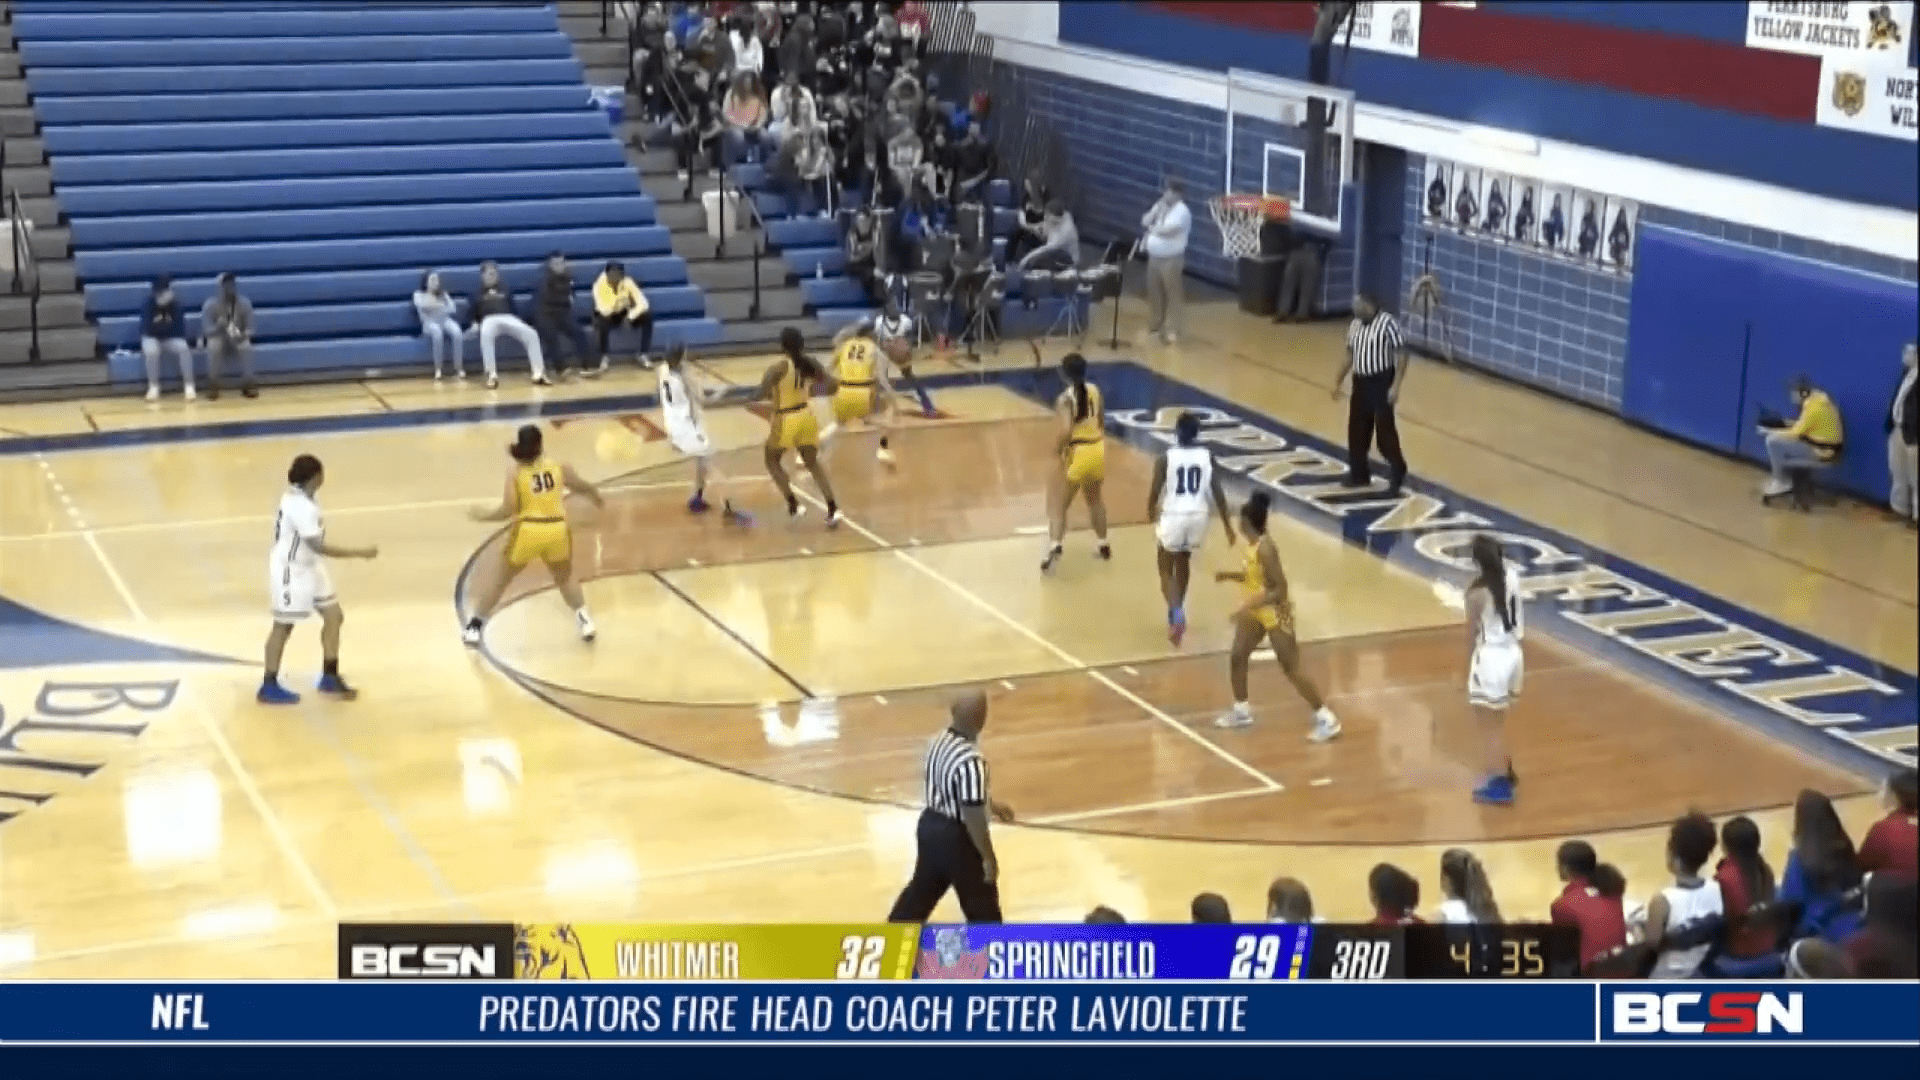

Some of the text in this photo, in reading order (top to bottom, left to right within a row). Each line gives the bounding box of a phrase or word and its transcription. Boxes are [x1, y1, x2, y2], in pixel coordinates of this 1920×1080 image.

[1754, 15, 1860, 49] YELLOW JACKETS
[1886, 77, 1917, 100] NOR
[532, 471, 554, 493] 30
[1175, 466, 1201, 495] 10
